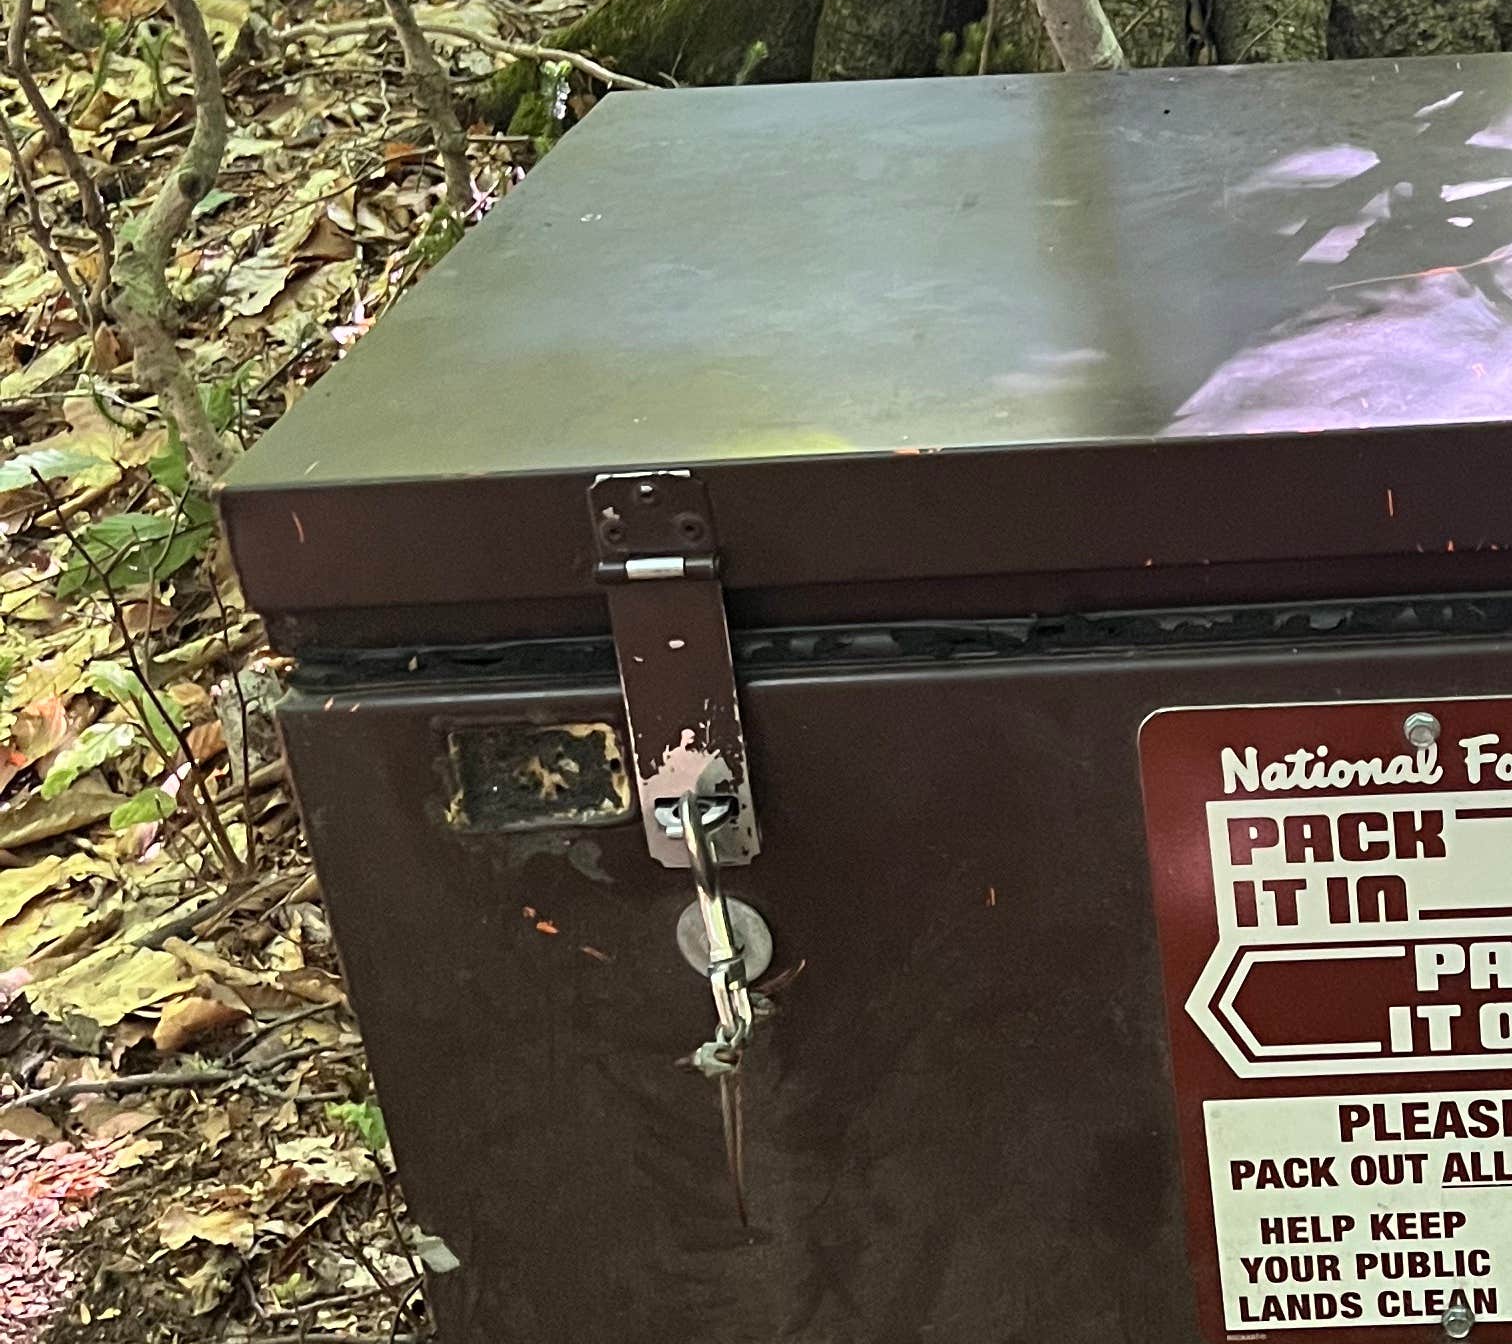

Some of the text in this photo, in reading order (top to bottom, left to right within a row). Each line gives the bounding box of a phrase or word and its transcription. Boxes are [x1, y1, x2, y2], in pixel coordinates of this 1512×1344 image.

[1220, 742, 1443, 794] National
[1227, 806, 1447, 865] PACK
[1233, 880, 1307, 928] IT
[1388, 1005, 1460, 1053] IT
[1230, 1156, 1339, 1190] PACK
[1350, 1154, 1429, 1187] OUT
[1260, 1212, 1467, 1245] HELP KEEP
[1240, 1248, 1491, 1284] YOUR PUBLIC
[1239, 1289, 1498, 1322] LANDS CLEAN
